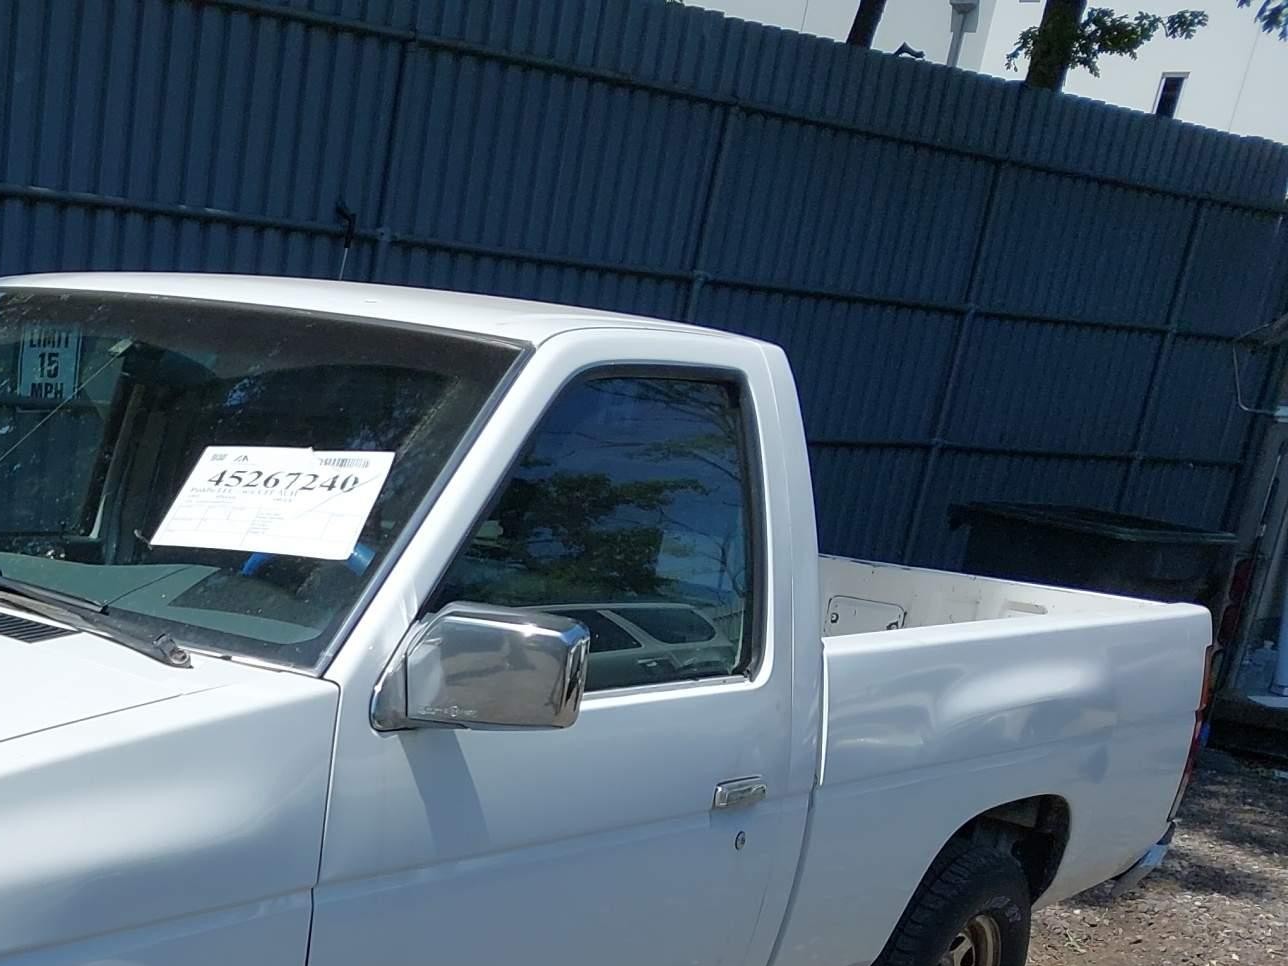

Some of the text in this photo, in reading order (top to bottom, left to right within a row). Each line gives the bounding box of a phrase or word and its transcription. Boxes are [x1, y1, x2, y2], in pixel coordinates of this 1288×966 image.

[28, 327, 70, 348] LIMIT
[38, 352, 59, 378] 15
[29, 382, 64, 399] MPH
[208, 469, 360, 493] 45267240
